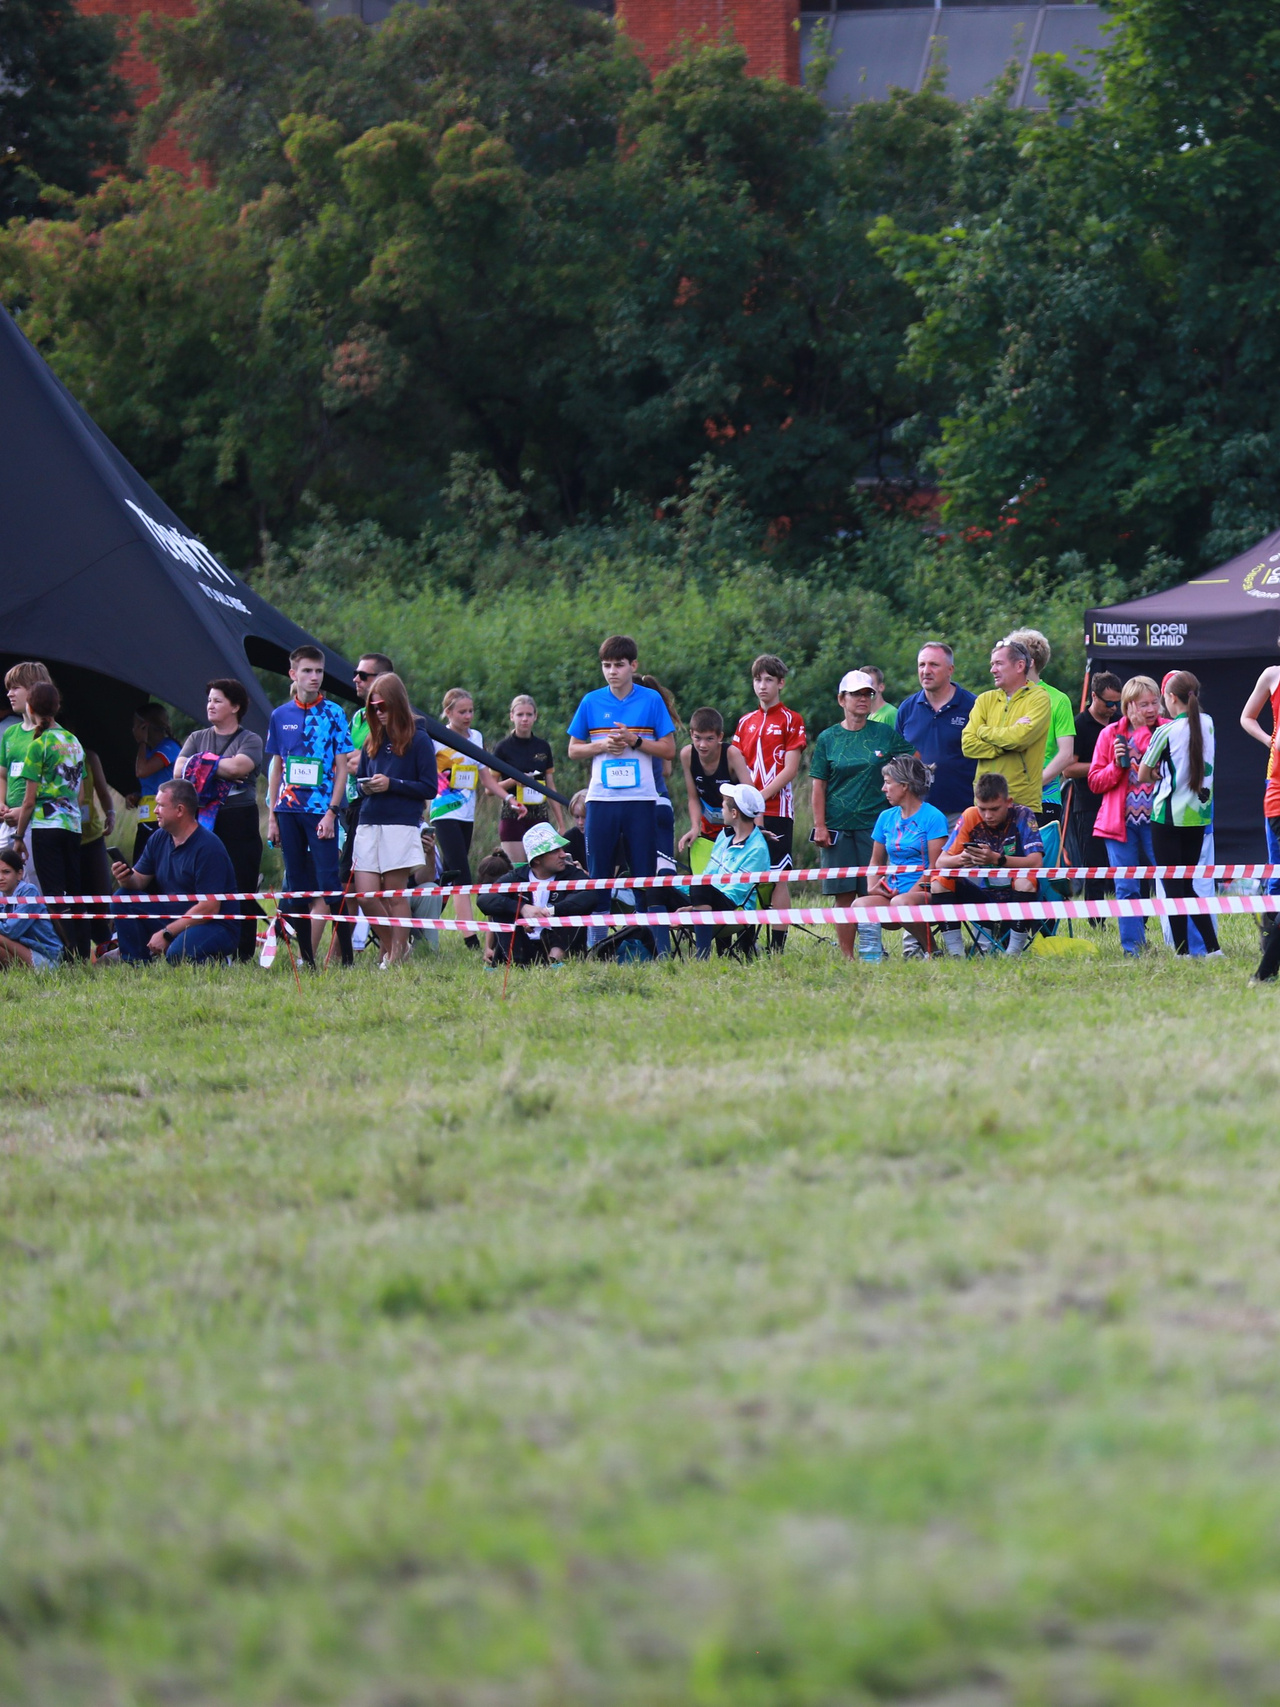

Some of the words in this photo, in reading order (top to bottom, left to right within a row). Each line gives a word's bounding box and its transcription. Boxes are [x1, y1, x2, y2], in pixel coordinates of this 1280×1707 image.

[1096, 622, 1140, 635] TIMING
[1107, 635, 1139, 646] BAND
[1151, 635, 1184, 646] BAND
